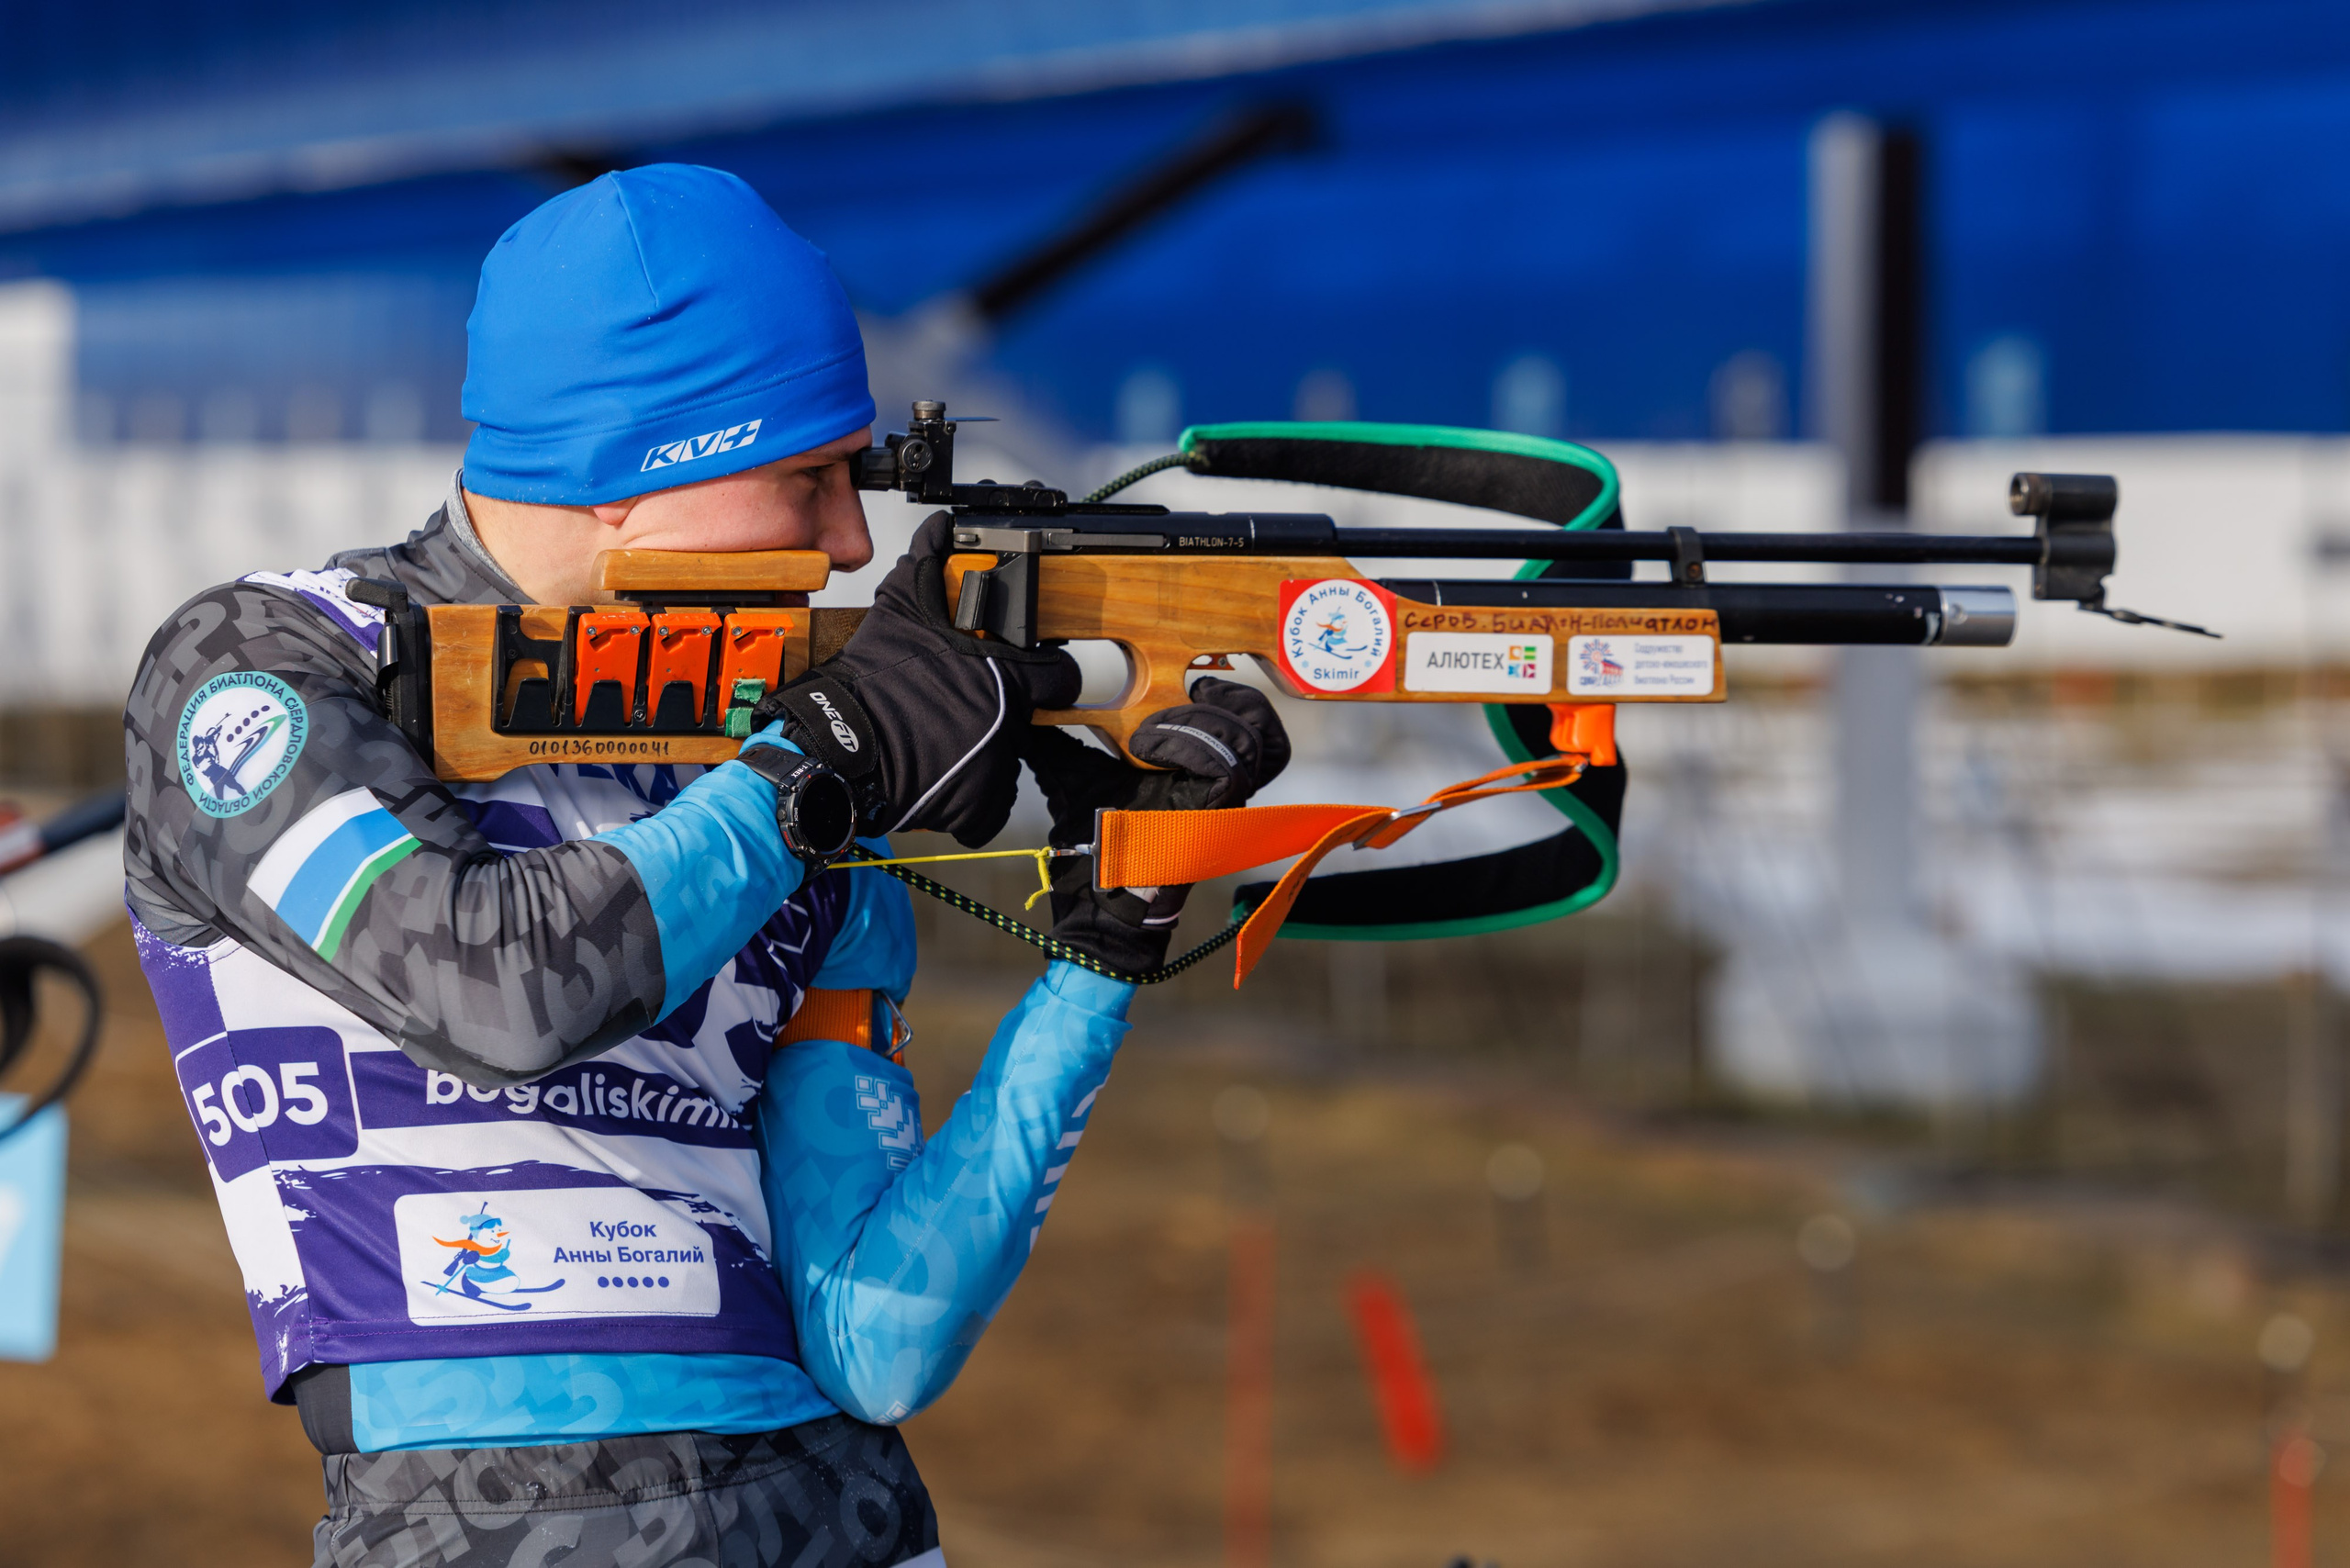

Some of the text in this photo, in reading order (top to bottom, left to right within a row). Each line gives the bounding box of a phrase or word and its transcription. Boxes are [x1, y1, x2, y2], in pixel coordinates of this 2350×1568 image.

[1289, 587, 1383, 658] Кубок Анны Богалий
[1427, 651, 1505, 669] АЛЮТЕХ
[1314, 667, 1360, 679] Skimir
[179, 673, 304, 813] ФЕДЕРАЦИЯ БИАТЛОНА СВЕРДЛОВСКОЙ ОБЛАСТИ
[529, 739, 669, 757] 0101360000041
[1203, 735, 1234, 762] RACING
[790, 764, 809, 778] T-REX
[192, 1061, 329, 1147] 505
[589, 1220, 657, 1241] Кубок
[553, 1246, 704, 1263] Анны Богалий
